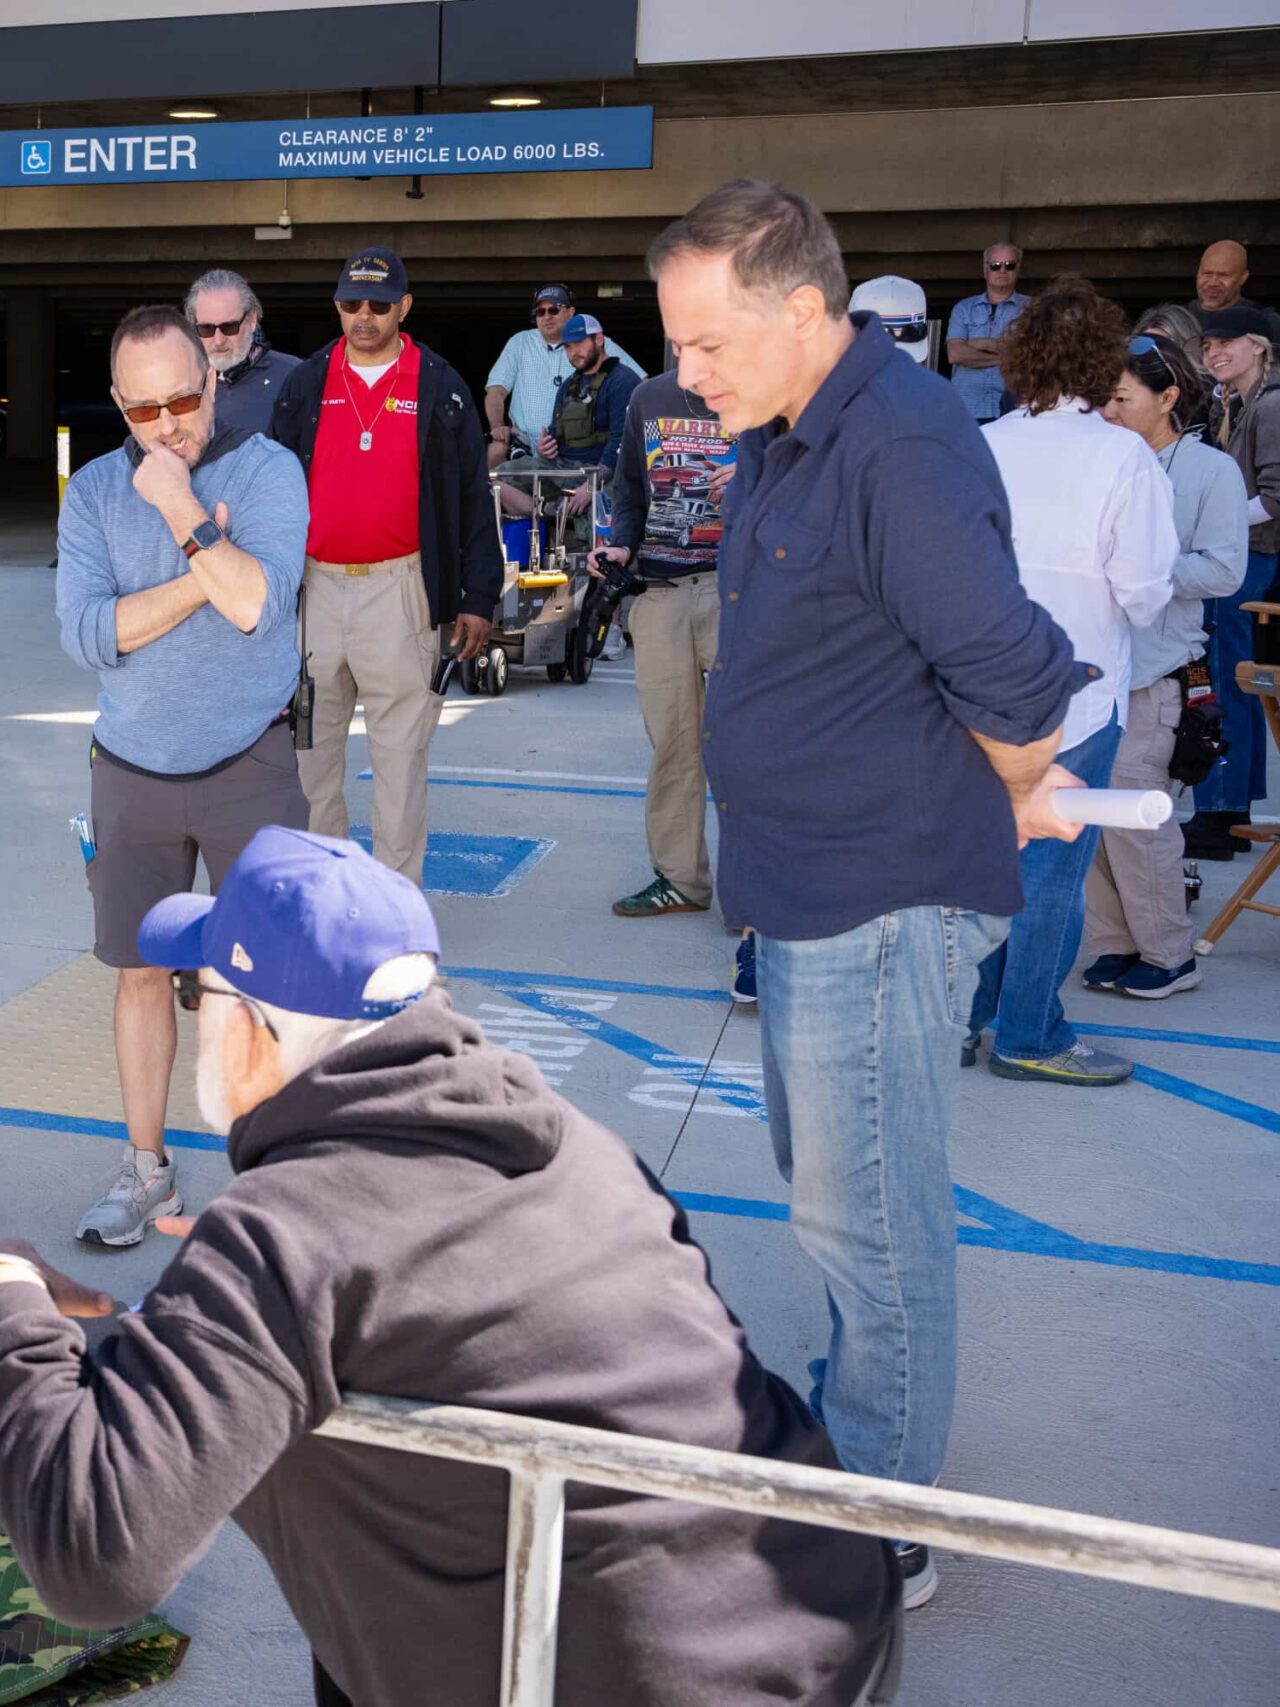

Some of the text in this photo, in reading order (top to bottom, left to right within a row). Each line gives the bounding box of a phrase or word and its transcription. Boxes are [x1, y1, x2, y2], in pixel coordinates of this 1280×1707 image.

[279, 126, 433, 147] CLEARANCE 8' 2"
[64, 135, 197, 173] ENTER
[278, 142, 605, 167] MAXIMUM VEHICLE LOAD 6000 LBS.
[662, 419, 738, 438] HARRY
